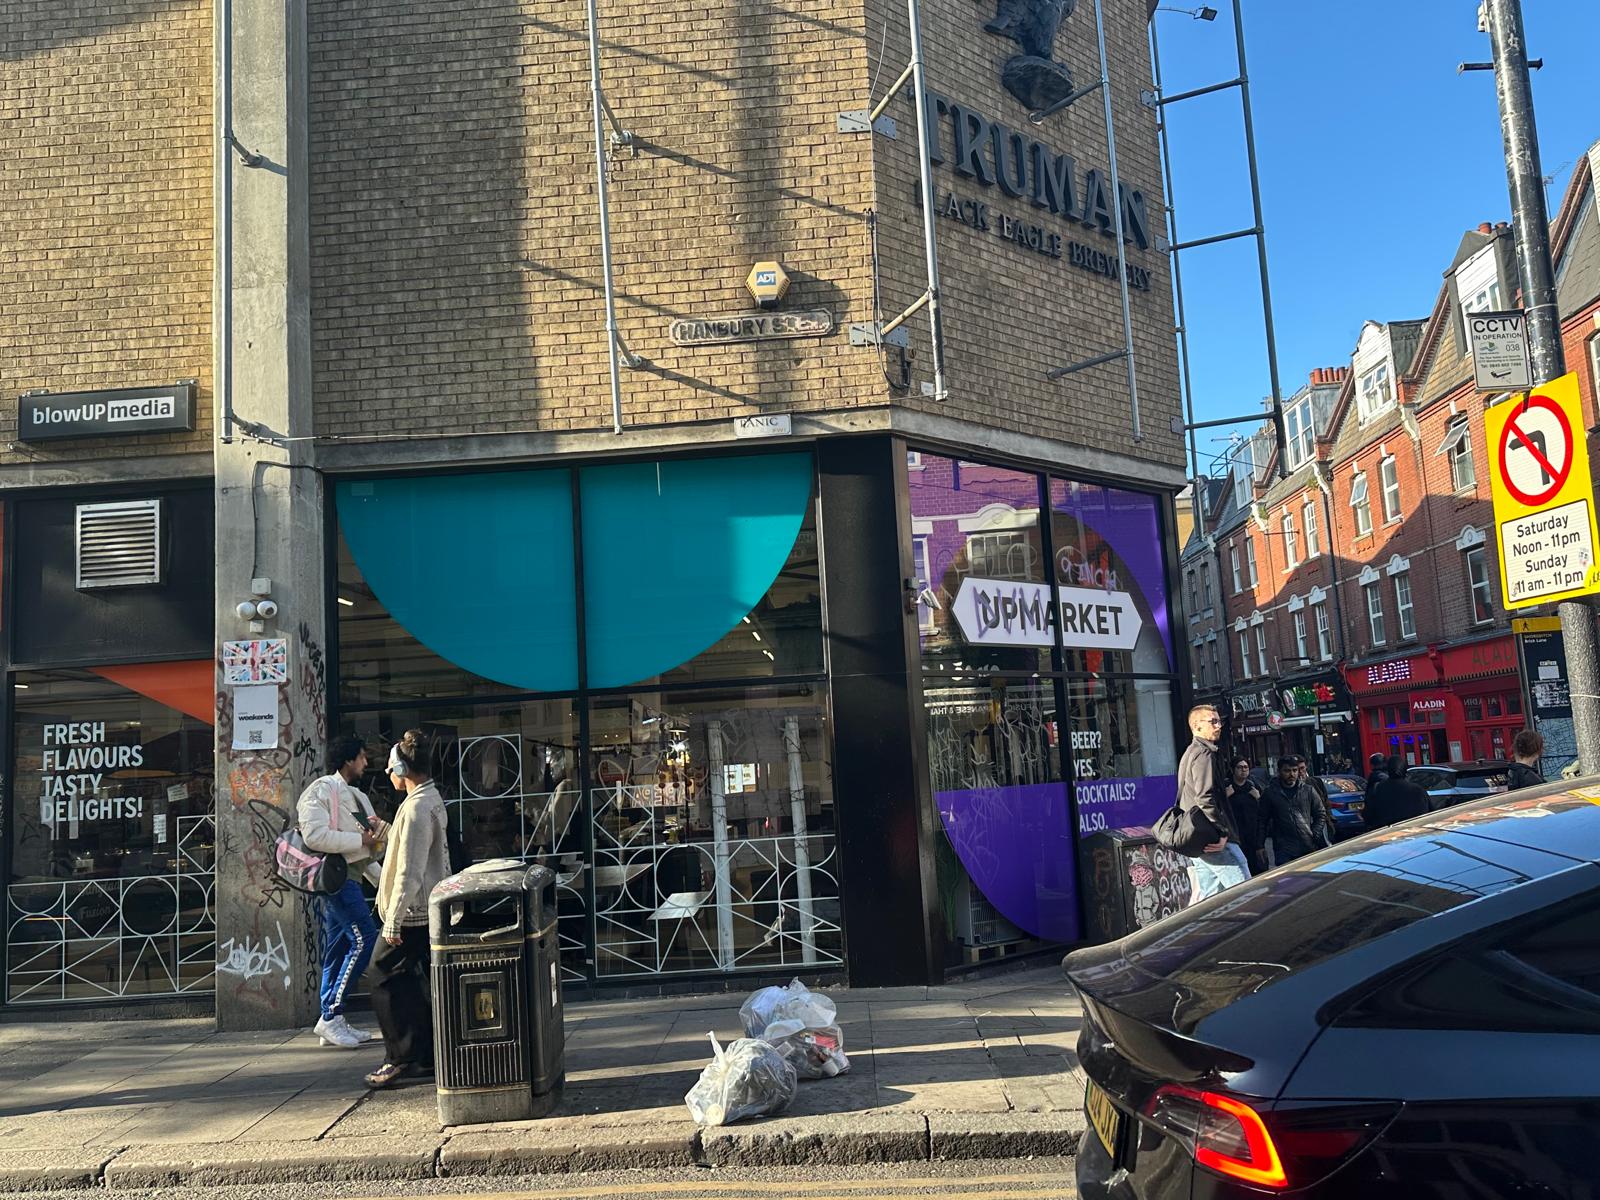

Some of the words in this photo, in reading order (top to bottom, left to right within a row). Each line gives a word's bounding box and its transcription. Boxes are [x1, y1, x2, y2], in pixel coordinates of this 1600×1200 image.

[909, 87, 1149, 249] TRUMAN
[1000, 212, 1062, 258] EAGLE
[756, 272, 776, 285] ADT
[679, 318, 766, 341] HANBURY
[1473, 318, 1519, 333] CCTV
[1505, 343, 1521, 352] 038
[33, 404, 106, 426] blowUP
[110, 399, 171, 421] media
[1516, 515, 1569, 538] Saturday
[1513, 541, 1542, 557] Noon
[1526, 554, 1568, 573] Sunday
[982, 592, 1123, 636] UPMARKET
[1368, 660, 1411, 685] ALADIN
[1413, 699, 1446, 709] ALADIN
[238, 713, 274, 721] weekends
[43, 721, 105, 746] FRESH
[1071, 731, 1102, 750] BEER?
[42, 745, 144, 772] FLAVOURS
[1073, 758, 1097, 777] YES.
[41, 773, 103, 797] TASTY
[1076, 782, 1136, 805] COCKTAILS?
[41, 796, 144, 822] DELIGHTS!
[1079, 813, 1109, 833] ALSO.
